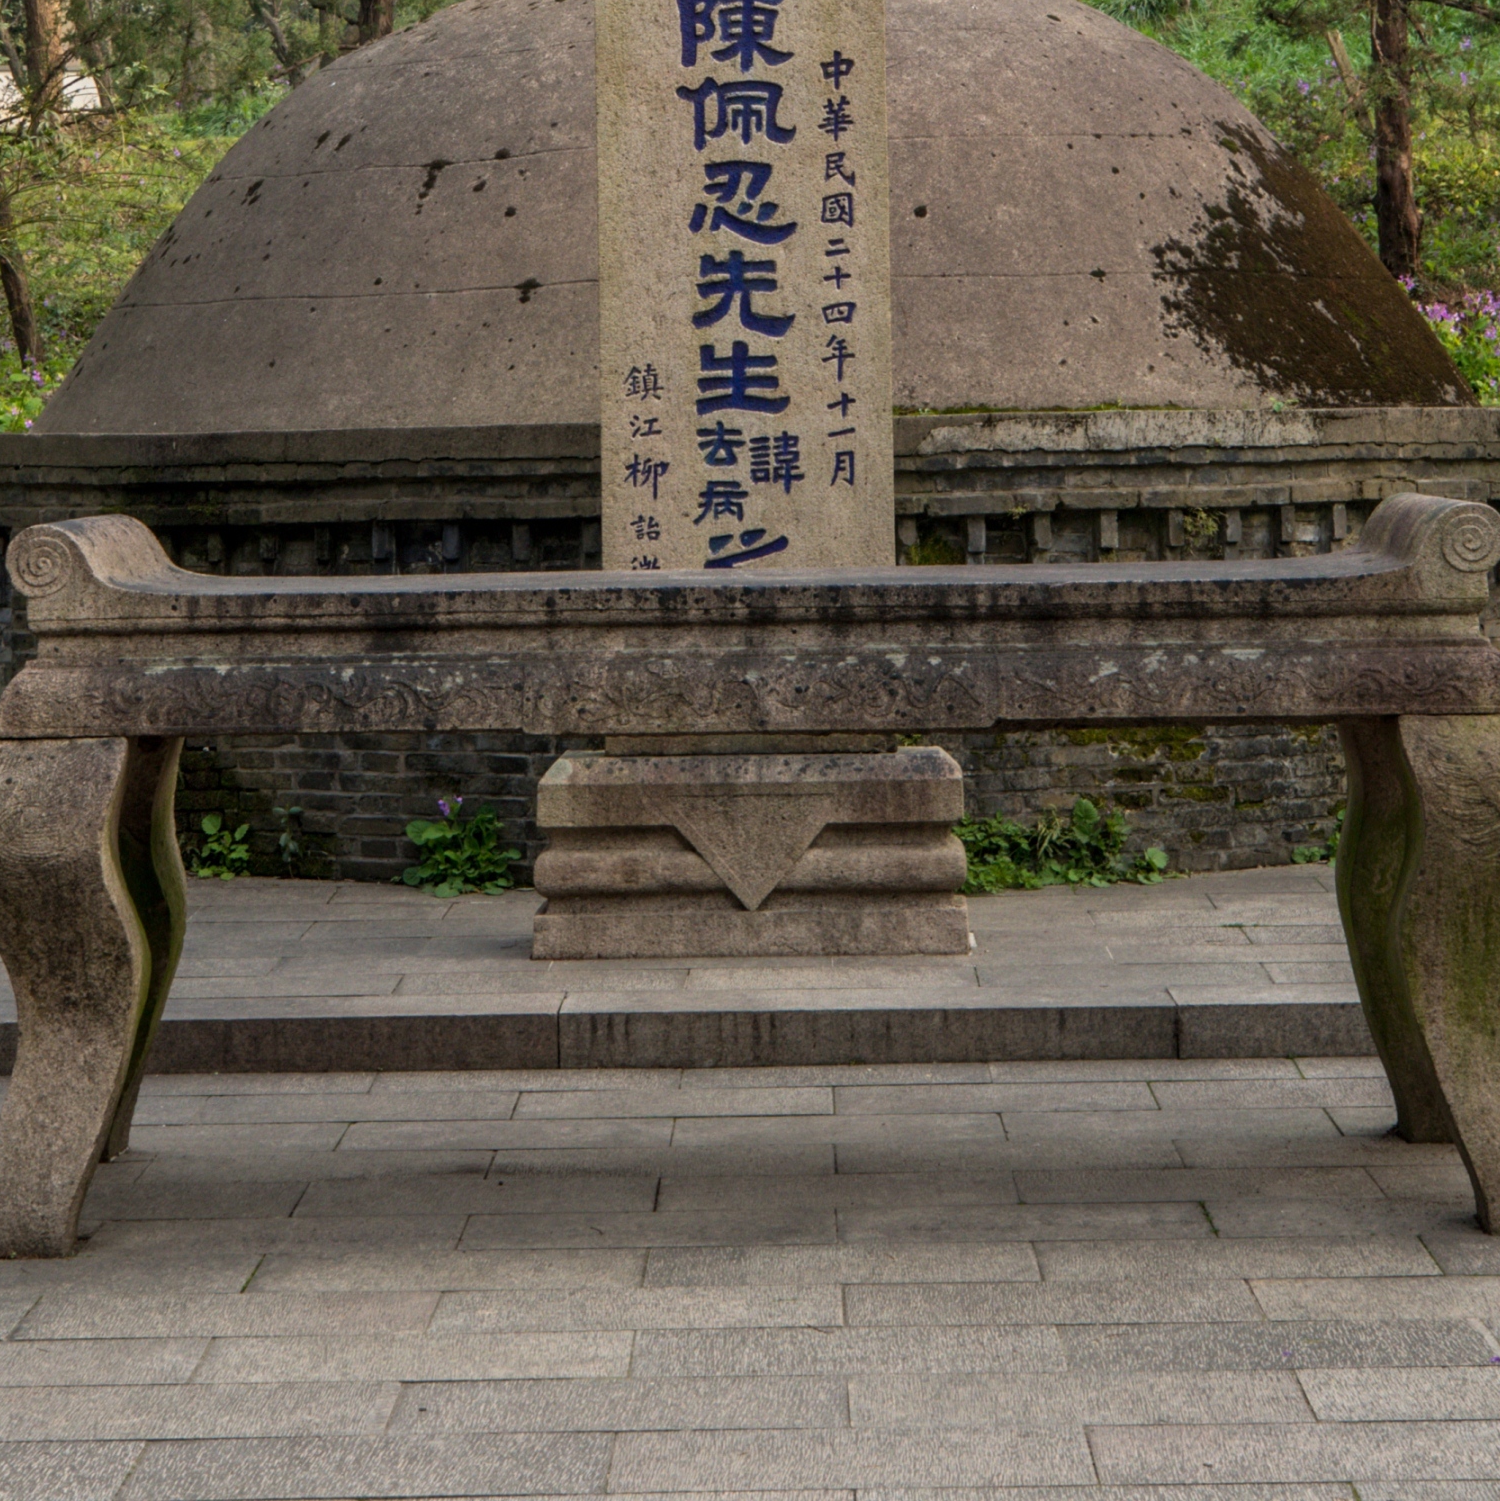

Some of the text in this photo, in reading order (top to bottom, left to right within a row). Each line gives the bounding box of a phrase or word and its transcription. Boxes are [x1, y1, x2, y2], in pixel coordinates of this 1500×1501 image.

[817, 50, 857, 487] 中華民國二十四年十一月
